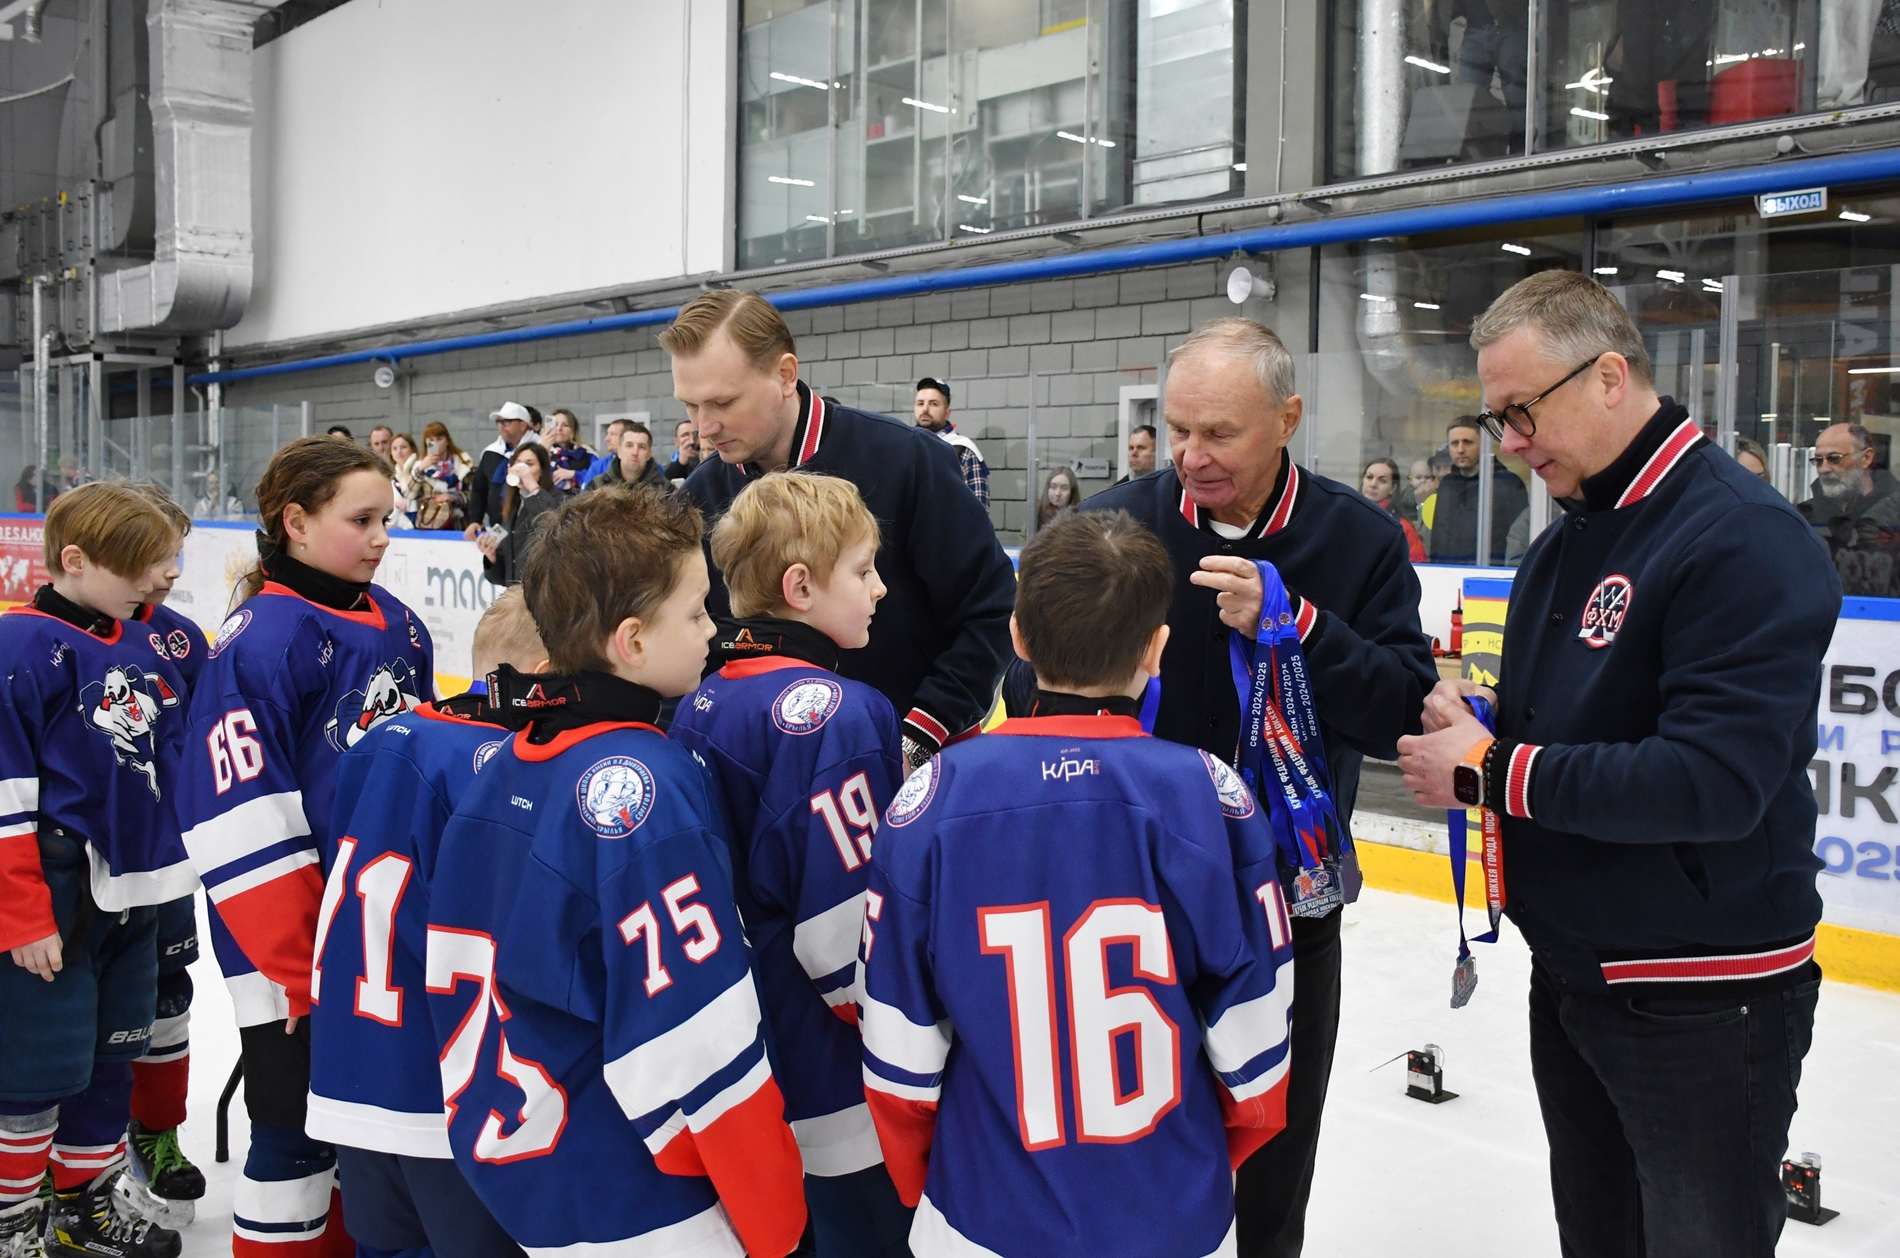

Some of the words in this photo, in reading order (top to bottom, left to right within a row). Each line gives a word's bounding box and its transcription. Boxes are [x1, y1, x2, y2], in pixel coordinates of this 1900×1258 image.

[1765, 193, 1820, 214] ВЫХОД
[1252, 661, 1267, 715] 2024/2025
[1290, 654, 1311, 706] 2024/2025
[207, 708, 265, 796] 66
[1279, 734, 1309, 776] ФЕДЕРАЦИИ
[1284, 783, 1302, 810] КУБОК
[1305, 774, 1323, 799] КУБОК
[810, 770, 881, 872] 19
[1486, 836, 1498, 866] ГОРОДА
[1488, 867, 1500, 898] ХОККЕЯ
[617, 872, 722, 998] 75
[1254, 880, 1294, 952] 1
[977, 897, 1182, 1152] 16
